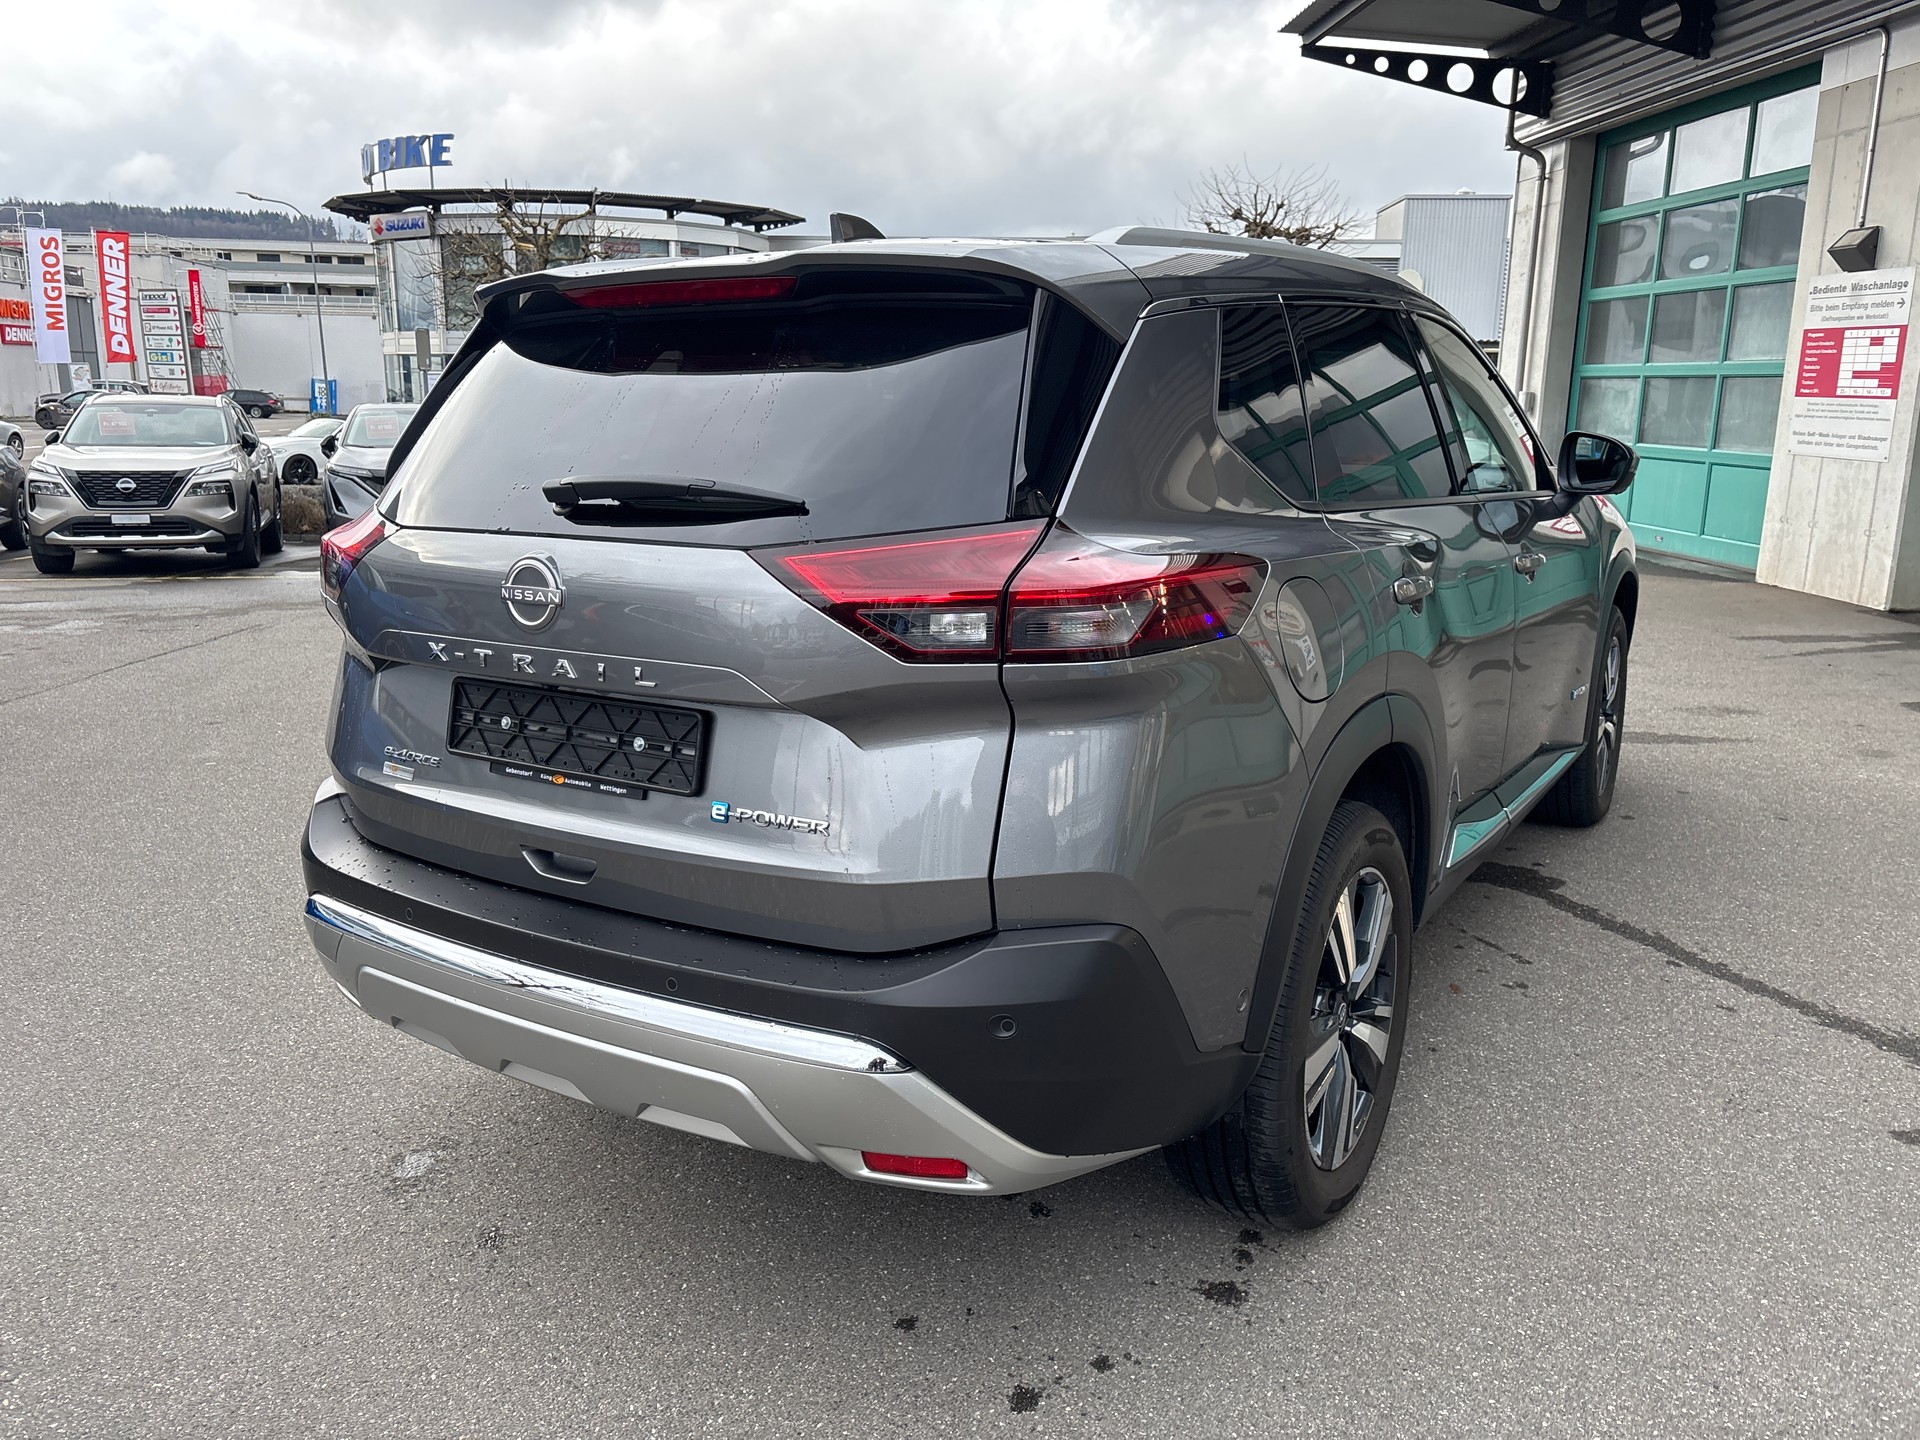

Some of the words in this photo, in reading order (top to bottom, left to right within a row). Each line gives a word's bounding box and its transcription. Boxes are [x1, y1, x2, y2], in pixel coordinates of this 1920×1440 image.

[378, 133, 455, 172] BIKE
[384, 216, 425, 232] SUZUKI
[39, 236, 65, 331] MIGROS
[102, 237, 131, 355] DENNER
[1813, 284, 1847, 295] Bediente
[1851, 280, 1909, 292] Waschanlage
[1810, 304, 1823, 312] Bitte
[1825, 304, 1840, 312] beim
[1841, 302, 1868, 311] Empfang
[1871, 300, 1895, 308] melden
[501, 588, 559, 603] NISSAN
[428, 641, 658, 688] X-TRAIL
[505, 767, 533, 776] Gebenstorf
[565, 778, 592, 787] Automobile
[600, 783, 627, 794] Wettingen
[711, 803, 831, 837] e-POWER
